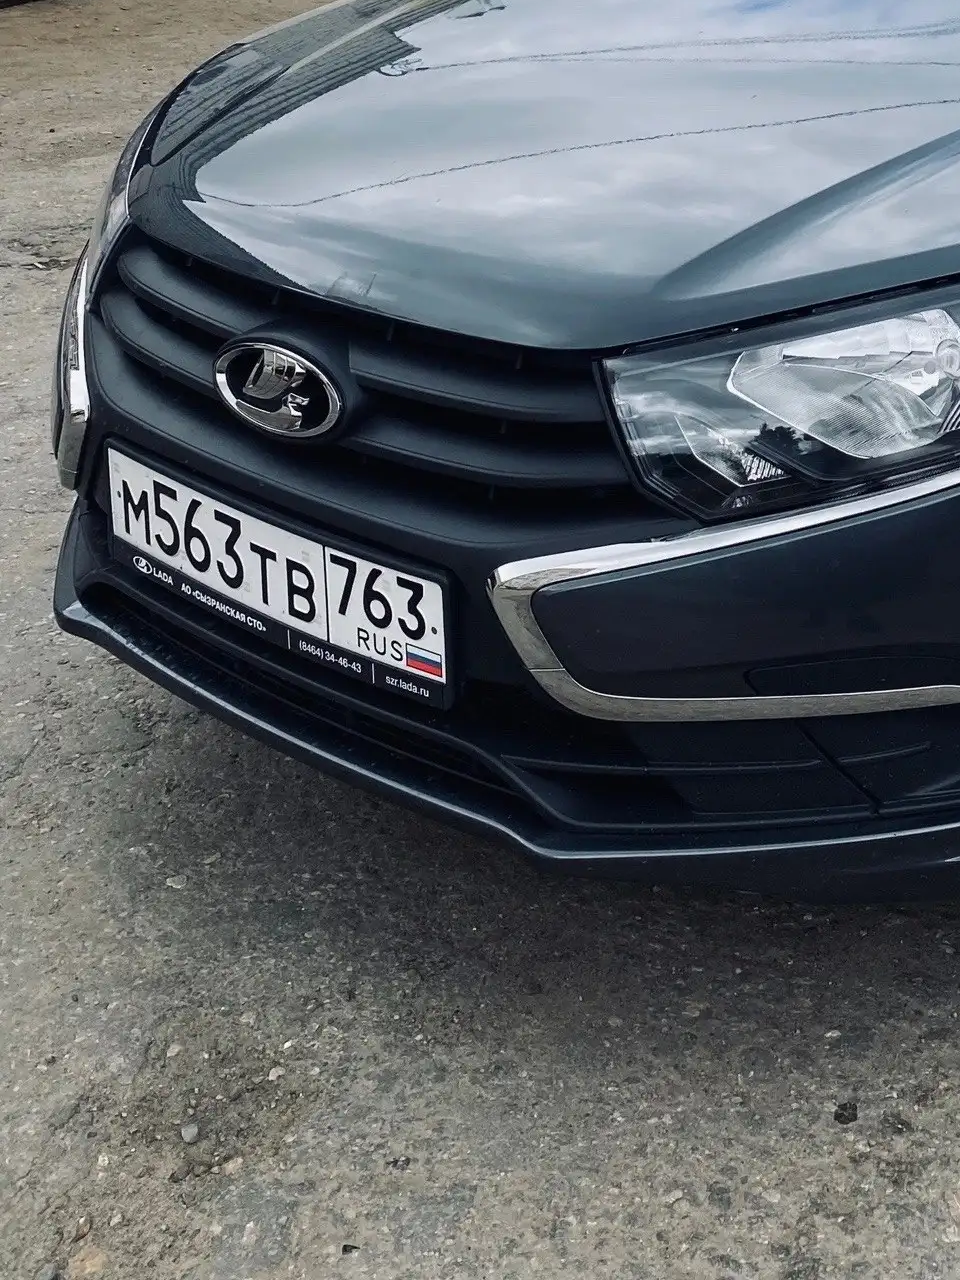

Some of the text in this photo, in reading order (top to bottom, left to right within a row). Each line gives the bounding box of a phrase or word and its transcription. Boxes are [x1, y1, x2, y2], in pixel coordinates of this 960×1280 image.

[121, 479, 427, 641] М563ТВ 763
[152, 567, 174, 586] LADA
[181, 582, 267, 632] АО «СЫЗРАНСКАЯ СТО»
[298, 639, 363, 674] (8464) 34-46-43
[356, 627, 404, 662] RUS
[385, 675, 430, 698] szr.lada.ru
